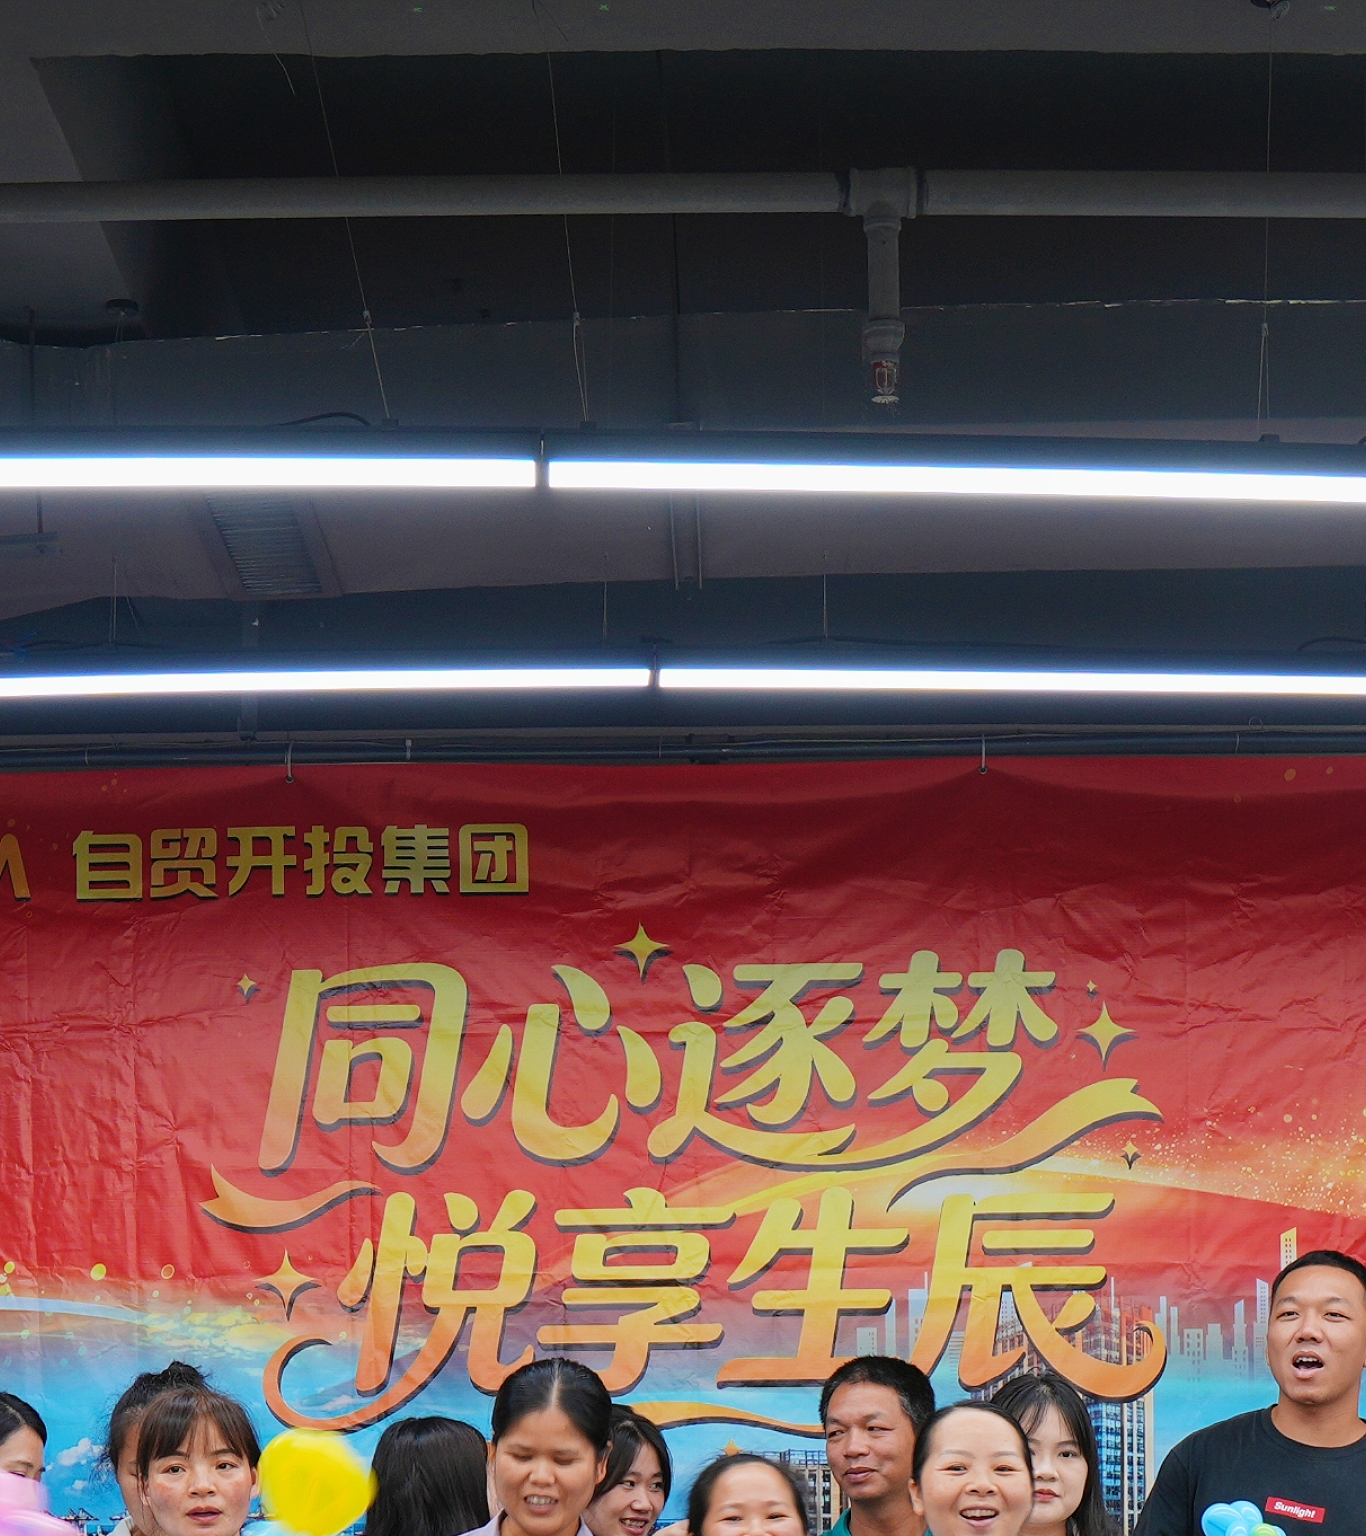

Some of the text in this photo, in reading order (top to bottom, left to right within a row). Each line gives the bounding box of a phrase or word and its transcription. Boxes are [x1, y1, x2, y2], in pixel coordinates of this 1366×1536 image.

[71, 823, 529, 899] 自贸开投集团
[257, 948, 1060, 1178] 同心逐梦
[333, 1186, 1167, 1402] 悦享生辰
[1274, 1501, 1316, 1519] Sunlight
